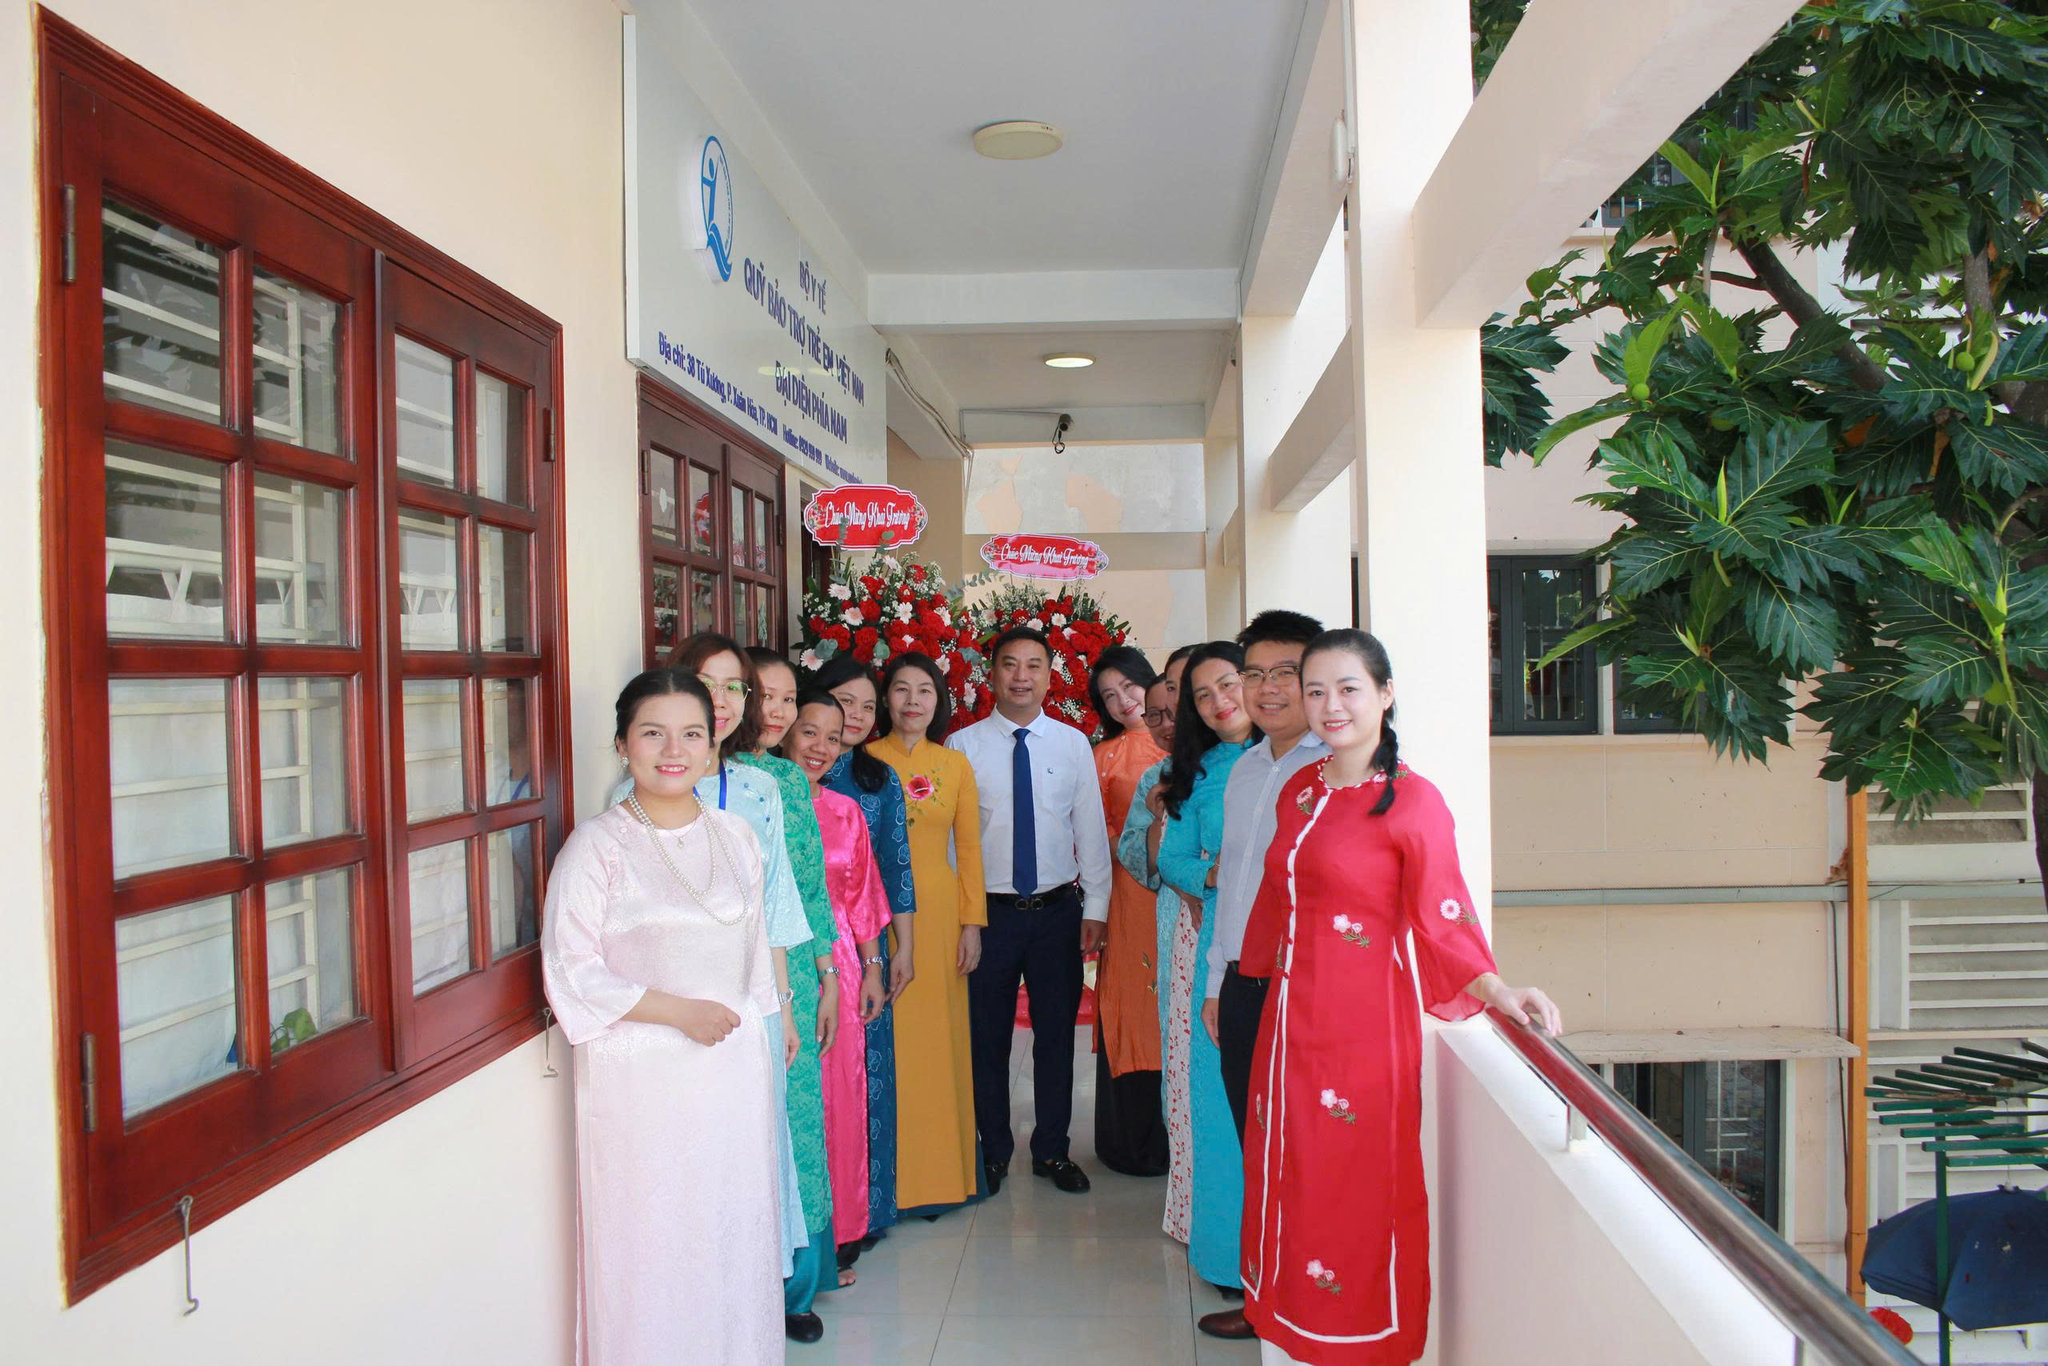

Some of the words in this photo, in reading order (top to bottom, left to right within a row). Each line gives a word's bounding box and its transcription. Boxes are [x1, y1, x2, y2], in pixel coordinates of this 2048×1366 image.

[800, 261, 810, 301] BỘ
[811, 274, 817, 302] Y
[817, 279, 827, 315] TẾ
[659, 331, 671, 365] Địa
[672, 344, 686, 371] chỉ:
[687, 353, 696, 378] 38
[696, 358, 705, 384] Tú
[767, 278, 787, 328] BẢO
[788, 304, 806, 355] TRỢ
[806, 324, 822, 365] TRẺ
[822, 341, 835, 377] EM
[851, 371, 865, 407] NAM
[775, 360, 791, 406] ĐẠI
[791, 374, 811, 420] DIỆN
[811, 391, 830, 432] PHÍA
[830, 407, 847, 444] NAM
